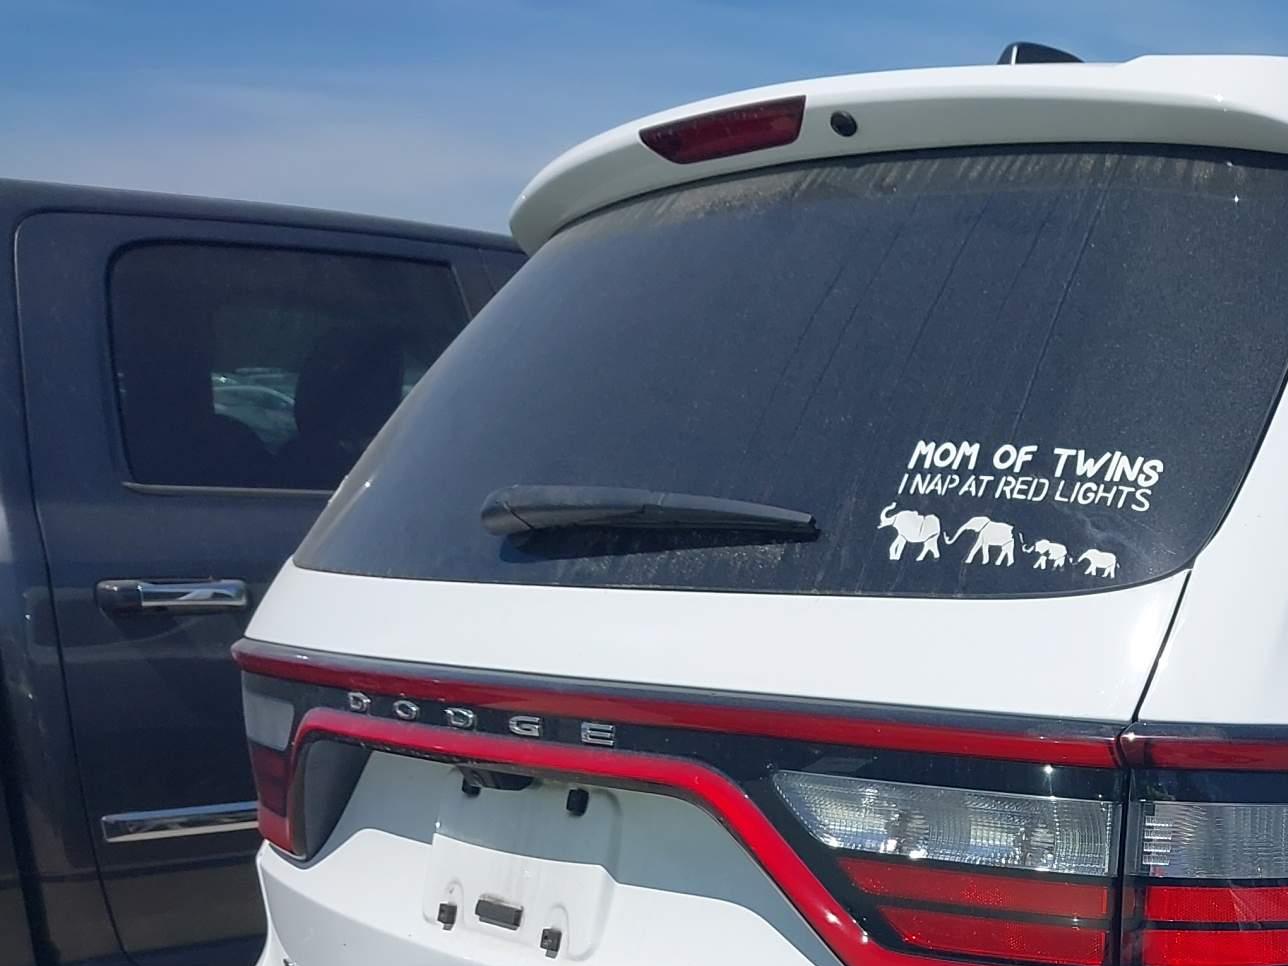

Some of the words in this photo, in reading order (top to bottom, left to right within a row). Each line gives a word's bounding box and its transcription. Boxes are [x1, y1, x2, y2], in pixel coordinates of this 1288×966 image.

[907, 439, 980, 470] MOM
[993, 444, 1038, 473] OF
[1053, 447, 1164, 488] TWINS
[897, 473, 909, 495] I
[995, 475, 1050, 502] RED
[1054, 479, 1152, 512] LIGHTS
[347, 691, 616, 747] DODGE
